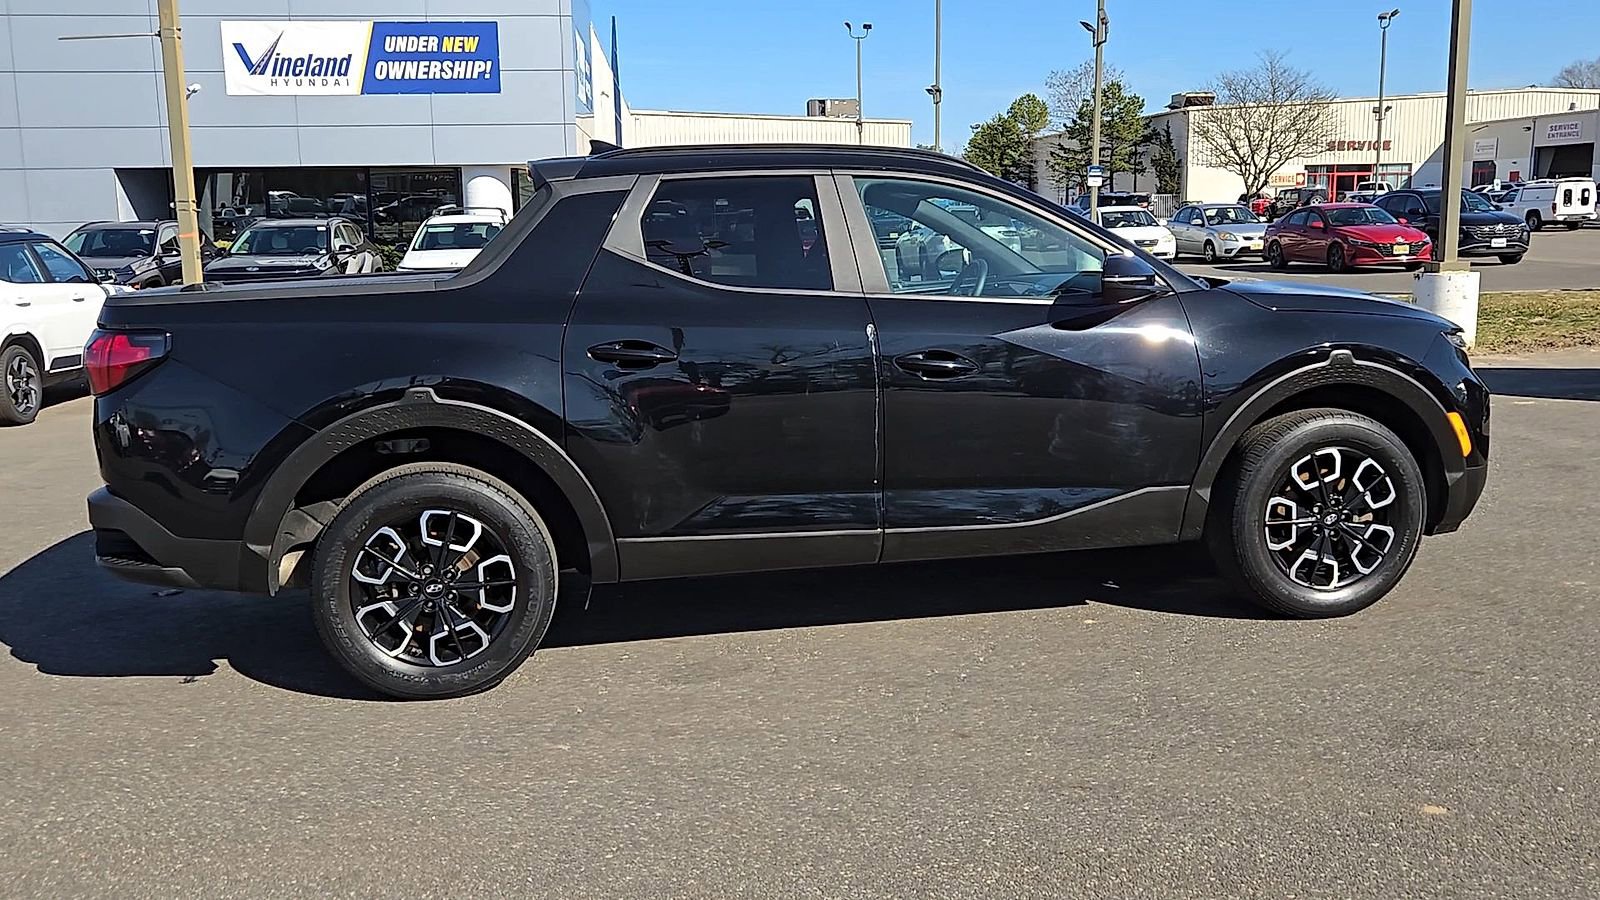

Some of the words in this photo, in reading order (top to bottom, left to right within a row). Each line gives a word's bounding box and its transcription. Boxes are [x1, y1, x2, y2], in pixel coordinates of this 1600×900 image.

[384, 35, 439, 53] UNDER
[441, 35, 479, 53] NEW
[232, 30, 352, 77] Vineland
[374, 60, 492, 80] OWNERSHIP!
[270, 78, 350, 87] HYUNDAI
[1549, 122, 1579, 131] SERVICE
[1547, 130, 1580, 139] ENTRANCE
[1327, 140, 1392, 151] SERVICE
[1270, 175, 1295, 183] SERVICE
